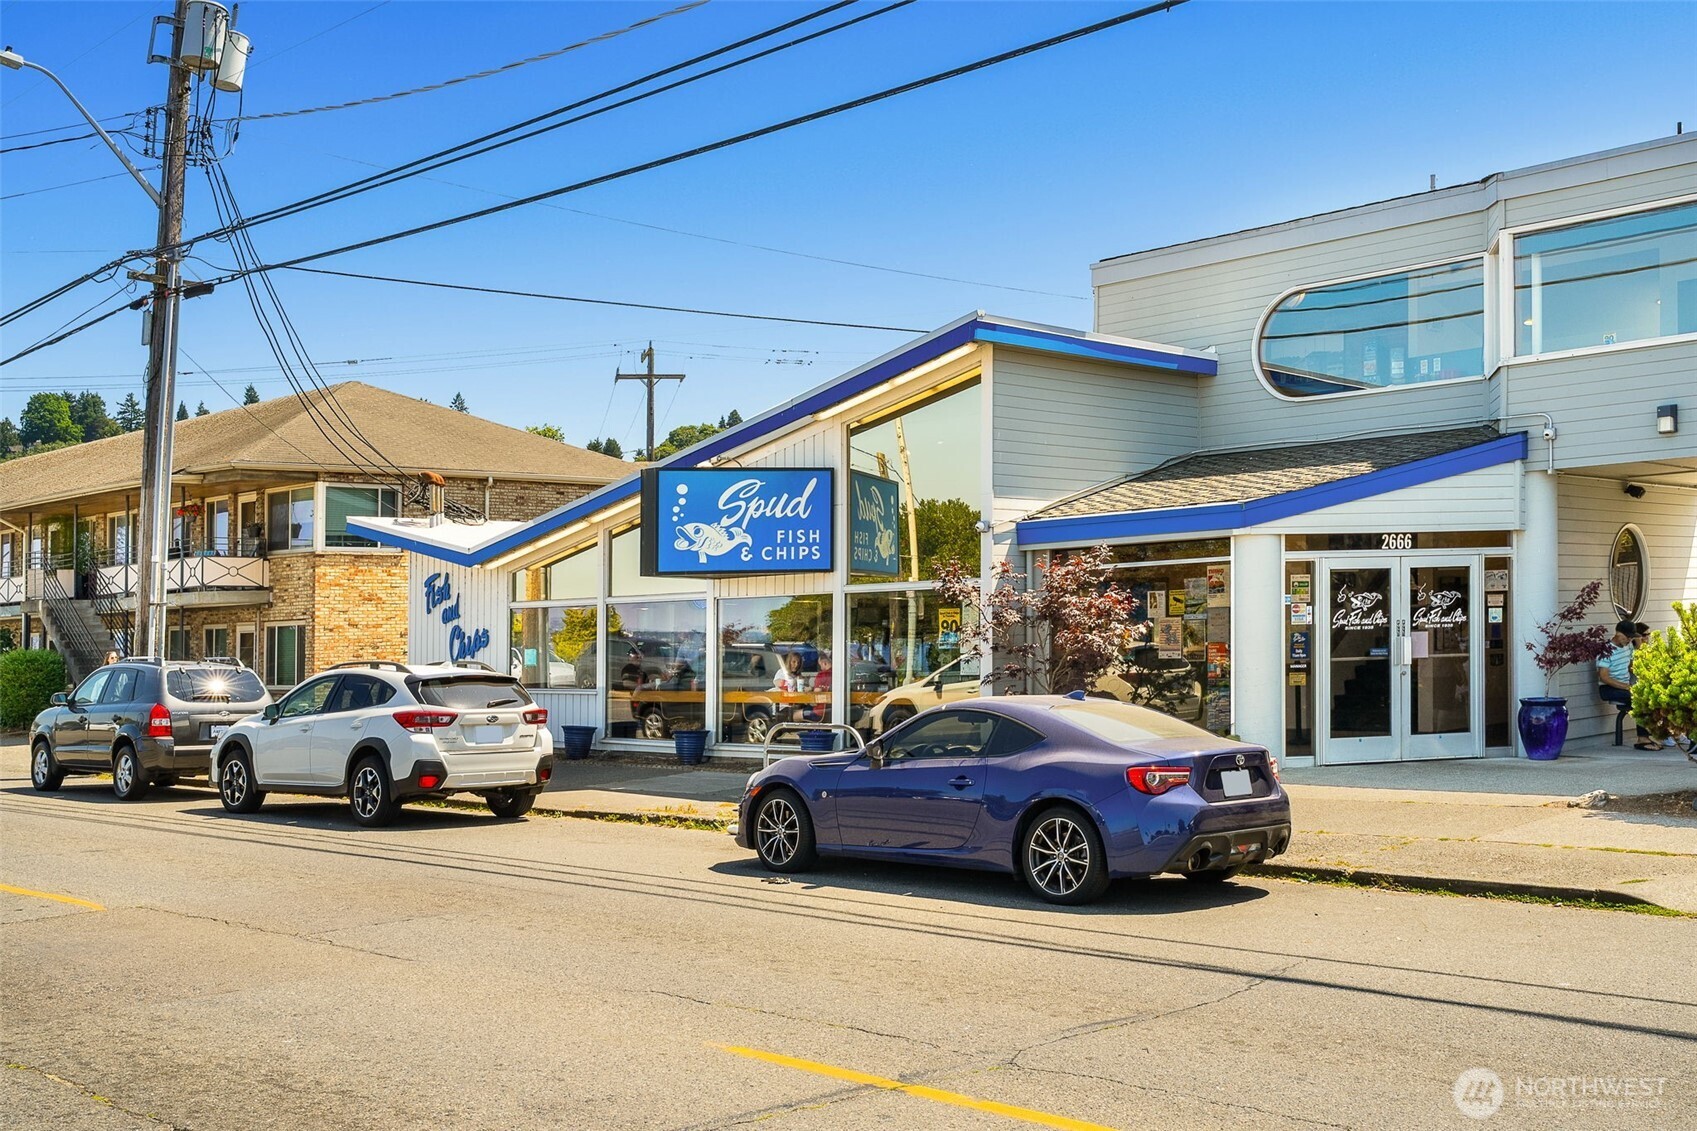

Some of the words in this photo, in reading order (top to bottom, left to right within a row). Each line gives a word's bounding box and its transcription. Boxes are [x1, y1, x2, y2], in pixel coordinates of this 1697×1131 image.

[718, 477, 818, 530] Spud
[776, 529, 820, 544] FISH
[1381, 533, 1412, 550] 2666
[740, 547, 753, 562] &
[761, 545, 821, 561] CHIPS
[424, 572, 451, 615] Fish
[441, 592, 461, 625] and
[449, 625, 489, 663] Chips
